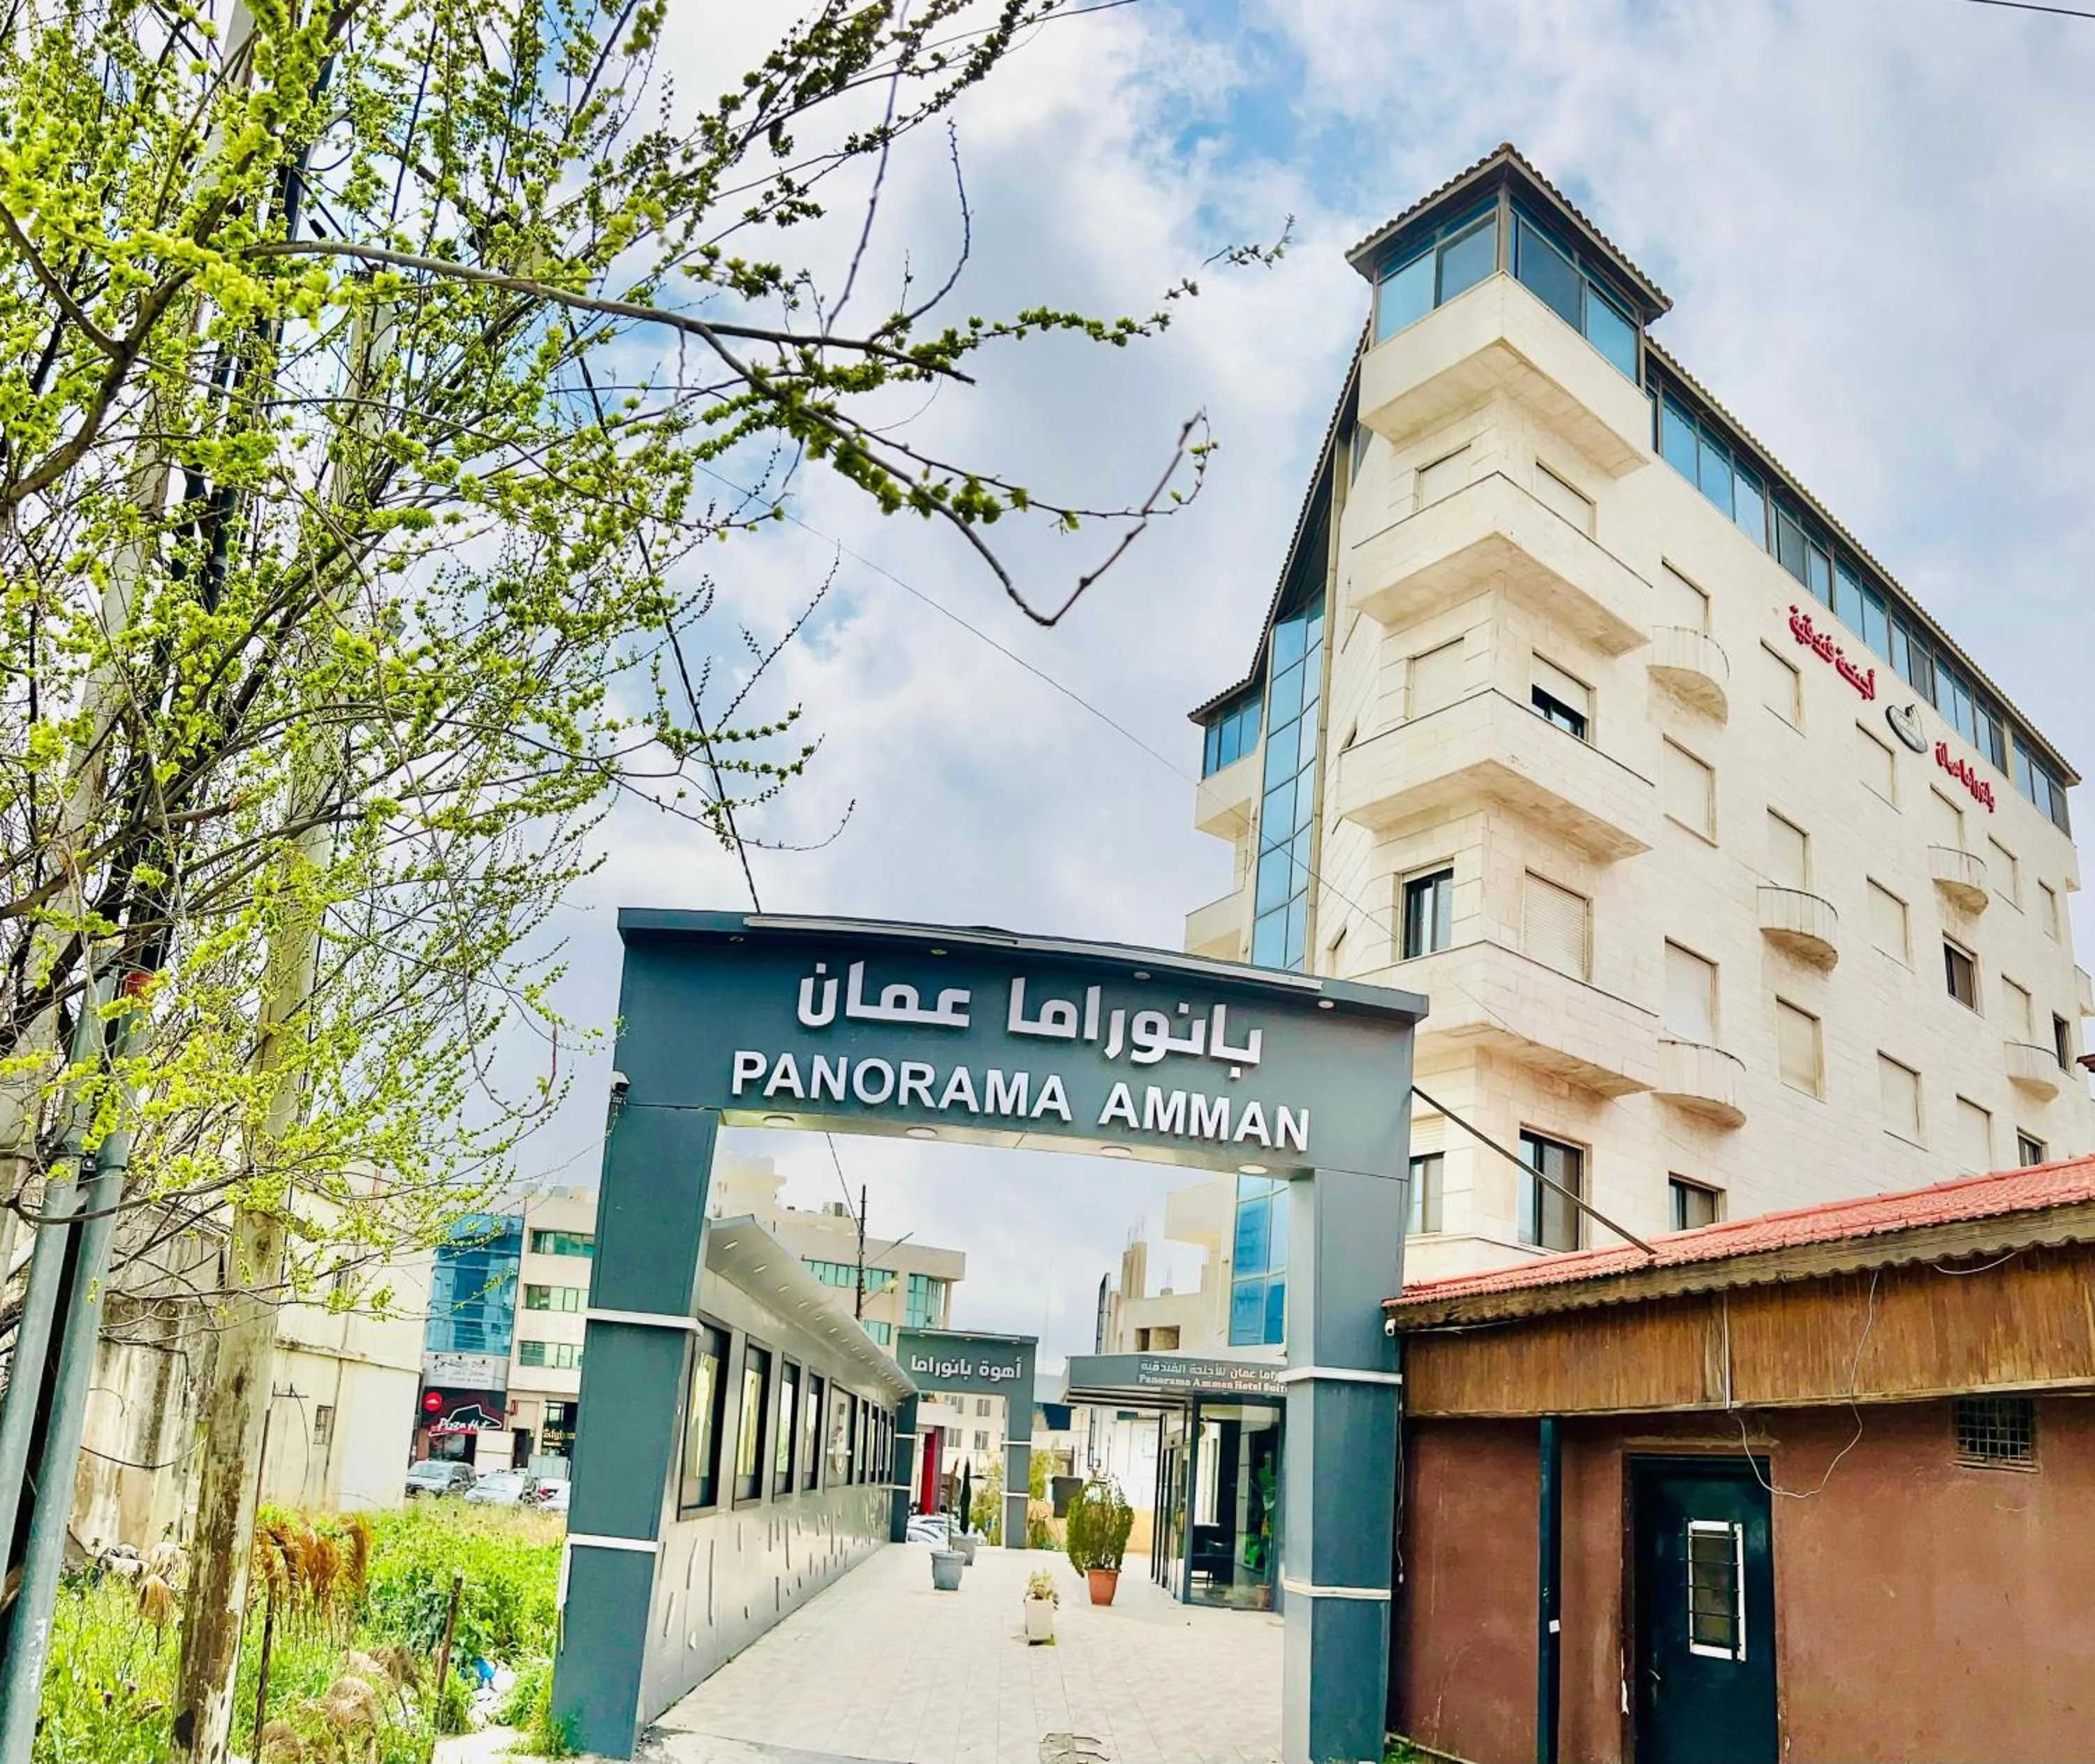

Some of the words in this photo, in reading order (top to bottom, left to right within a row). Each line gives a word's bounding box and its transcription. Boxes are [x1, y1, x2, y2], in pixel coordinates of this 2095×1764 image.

[796, 960, 972, 1029] عمان
[1007, 976, 1263, 1080] بانوراما
[731, 1050, 1073, 1122] PANORAMA
[1097, 1081, 1310, 1153] AMMAN
[911, 1354, 972, 1381] بانوراما
[1230, 1367, 1256, 1380] عمان
[1139, 1374, 1191, 1386] Panorama
[1192, 1377, 1233, 1390] Amman
[1235, 1381, 1262, 1392] Hotel
[1263, 1382, 1288, 1393] Suit
[439, 1417, 466, 1432] Pizza
